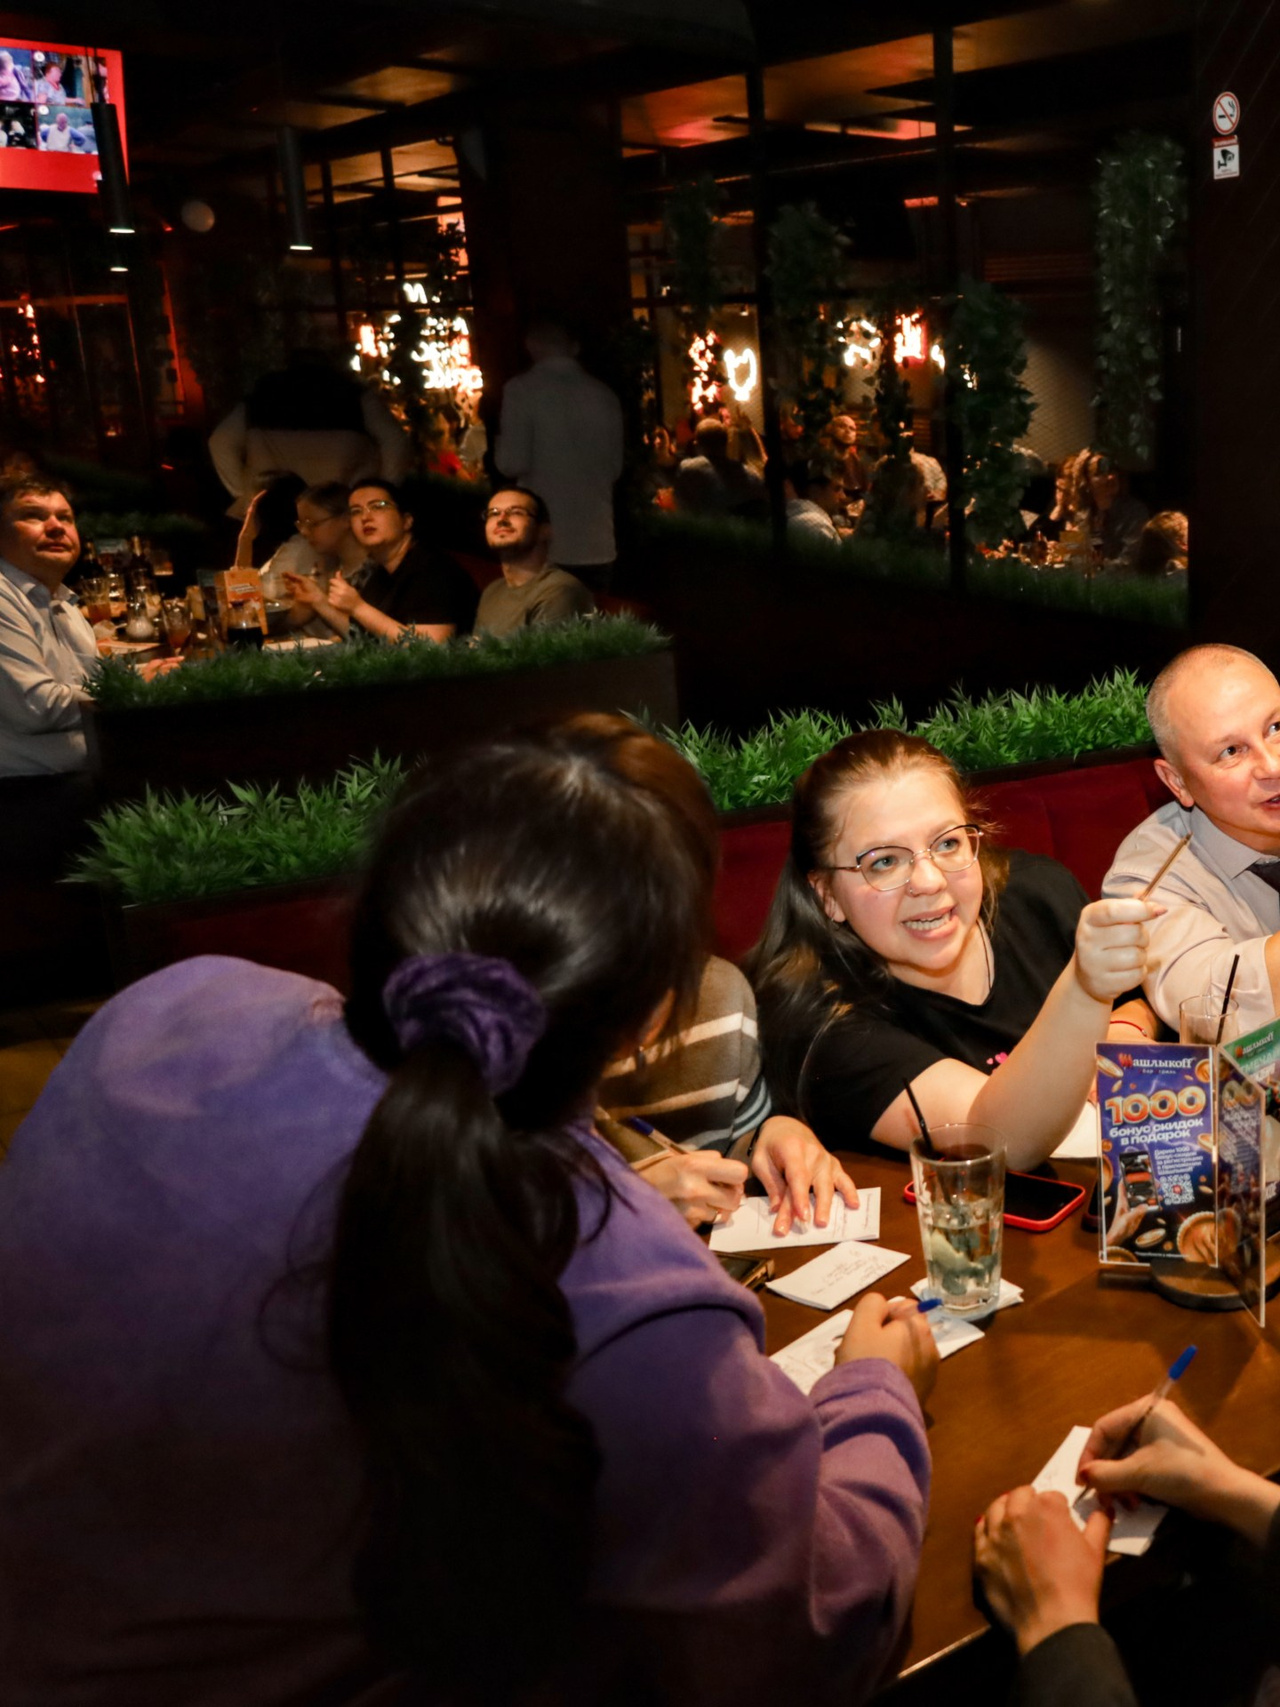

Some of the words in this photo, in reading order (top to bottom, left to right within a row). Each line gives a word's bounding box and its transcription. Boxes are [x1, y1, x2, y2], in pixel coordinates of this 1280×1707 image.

[1105, 1086, 1206, 1126] 1000
[1109, 1123, 1152, 1138] бонус
[1153, 1117, 1204, 1133] скидок
[1120, 1137, 1130, 1146] в
[1130, 1128, 1191, 1144] подарок
